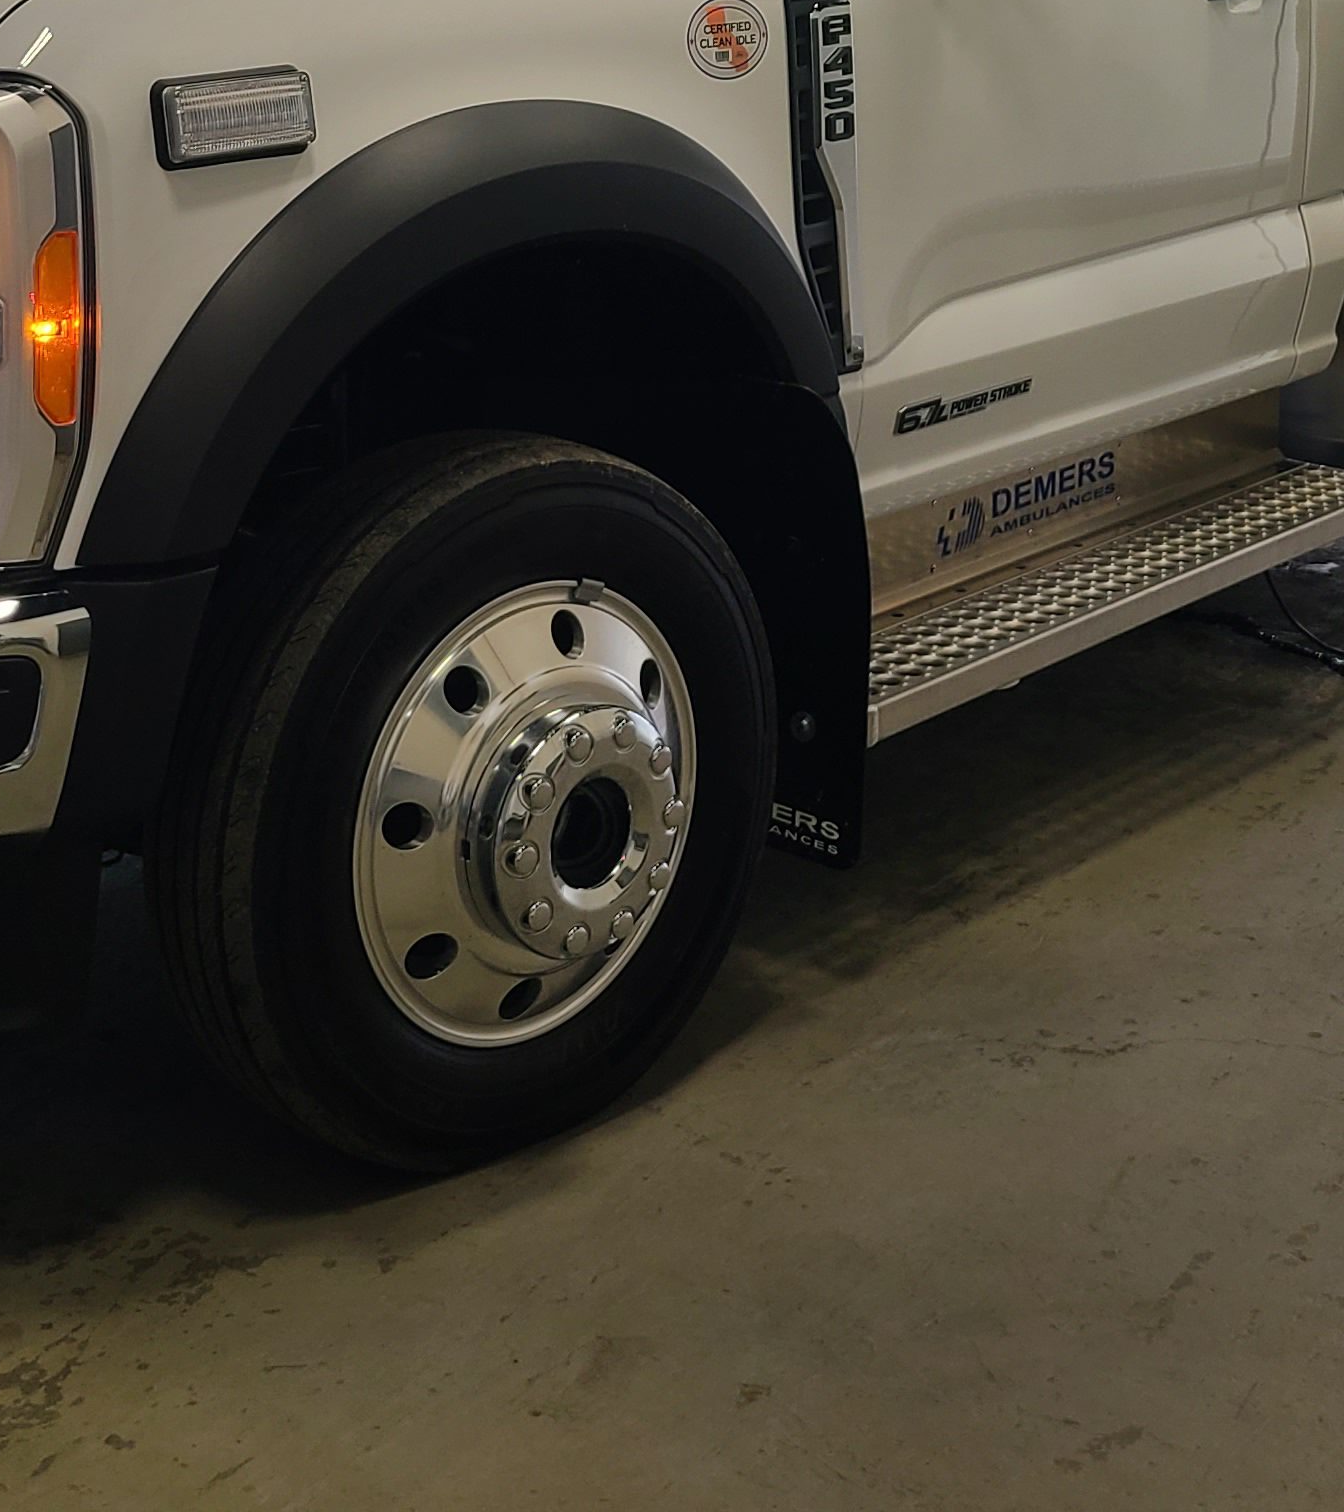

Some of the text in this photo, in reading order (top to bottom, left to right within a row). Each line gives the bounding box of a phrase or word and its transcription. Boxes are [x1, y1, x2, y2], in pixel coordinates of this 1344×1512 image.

[699, 34, 757, 49] CLEAN IDLE
[703, 21, 752, 35] CERTIFIED
[822, 13, 855, 142] F450
[895, 397, 949, 435] 6.7L
[949, 391, 989, 416] POWER
[988, 378, 1033, 403] STROKE
[990, 483, 1116, 537] AMBULANCES
[992, 451, 1115, 518] DEMERS
